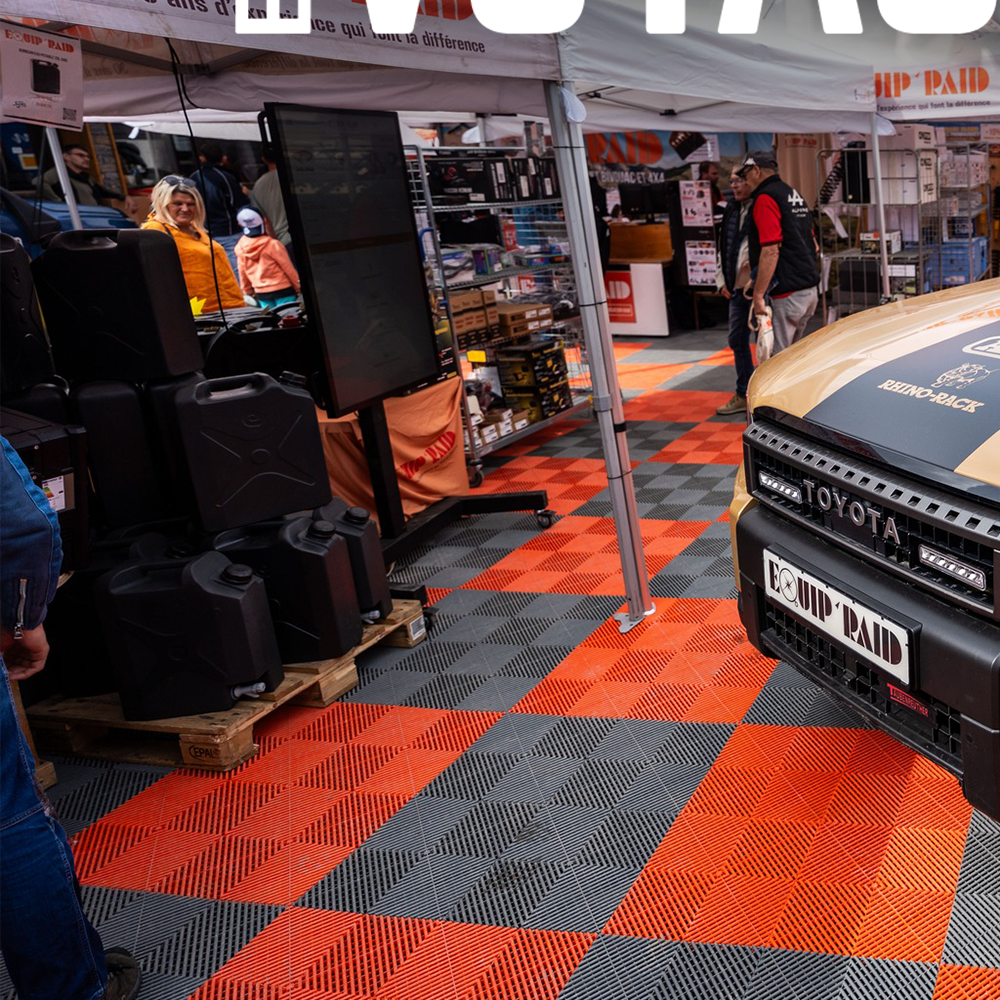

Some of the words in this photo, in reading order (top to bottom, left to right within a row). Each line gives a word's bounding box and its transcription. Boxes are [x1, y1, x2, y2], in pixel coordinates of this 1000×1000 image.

[341, 22, 366, 40] qui
[422, 31, 486, 53] différence
[877, 379, 985, 413] RHINO-RACK
[803, 479, 900, 545] TOYOTA
